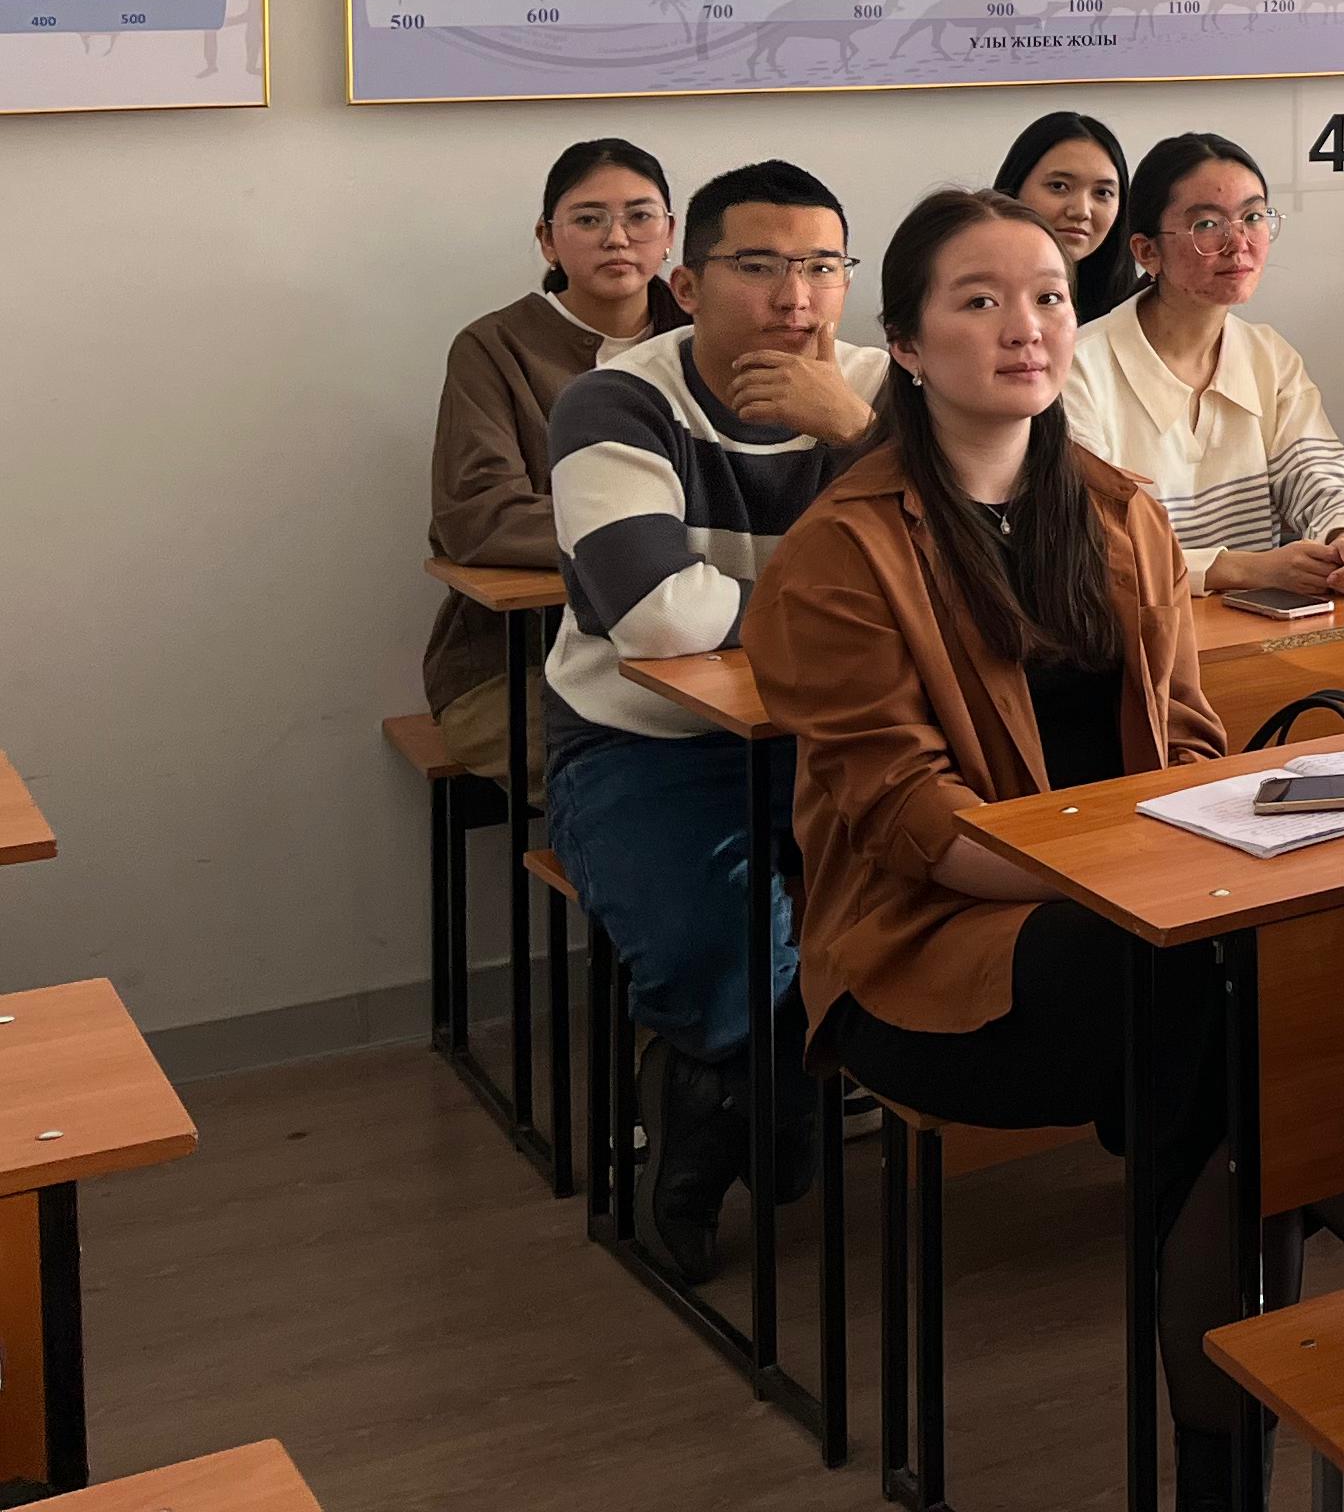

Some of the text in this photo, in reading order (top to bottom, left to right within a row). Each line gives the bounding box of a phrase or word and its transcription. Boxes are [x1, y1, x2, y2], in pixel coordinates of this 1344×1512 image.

[31, 13, 147, 27] 400 500
[389, 13, 426, 32] 500
[526, 7, 561, 25] 600
[702, 2, 734, 20] 700
[853, 2, 883, 20] 800
[986, 1, 1015, 18] 900
[1168, 0, 1201, 15] 1100
[1262, 0, 1296, 14] 1200
[1011, 35, 1063, 48] ЖІБЕК
[1066, 34, 1117, 47] ЖОЛЫ
